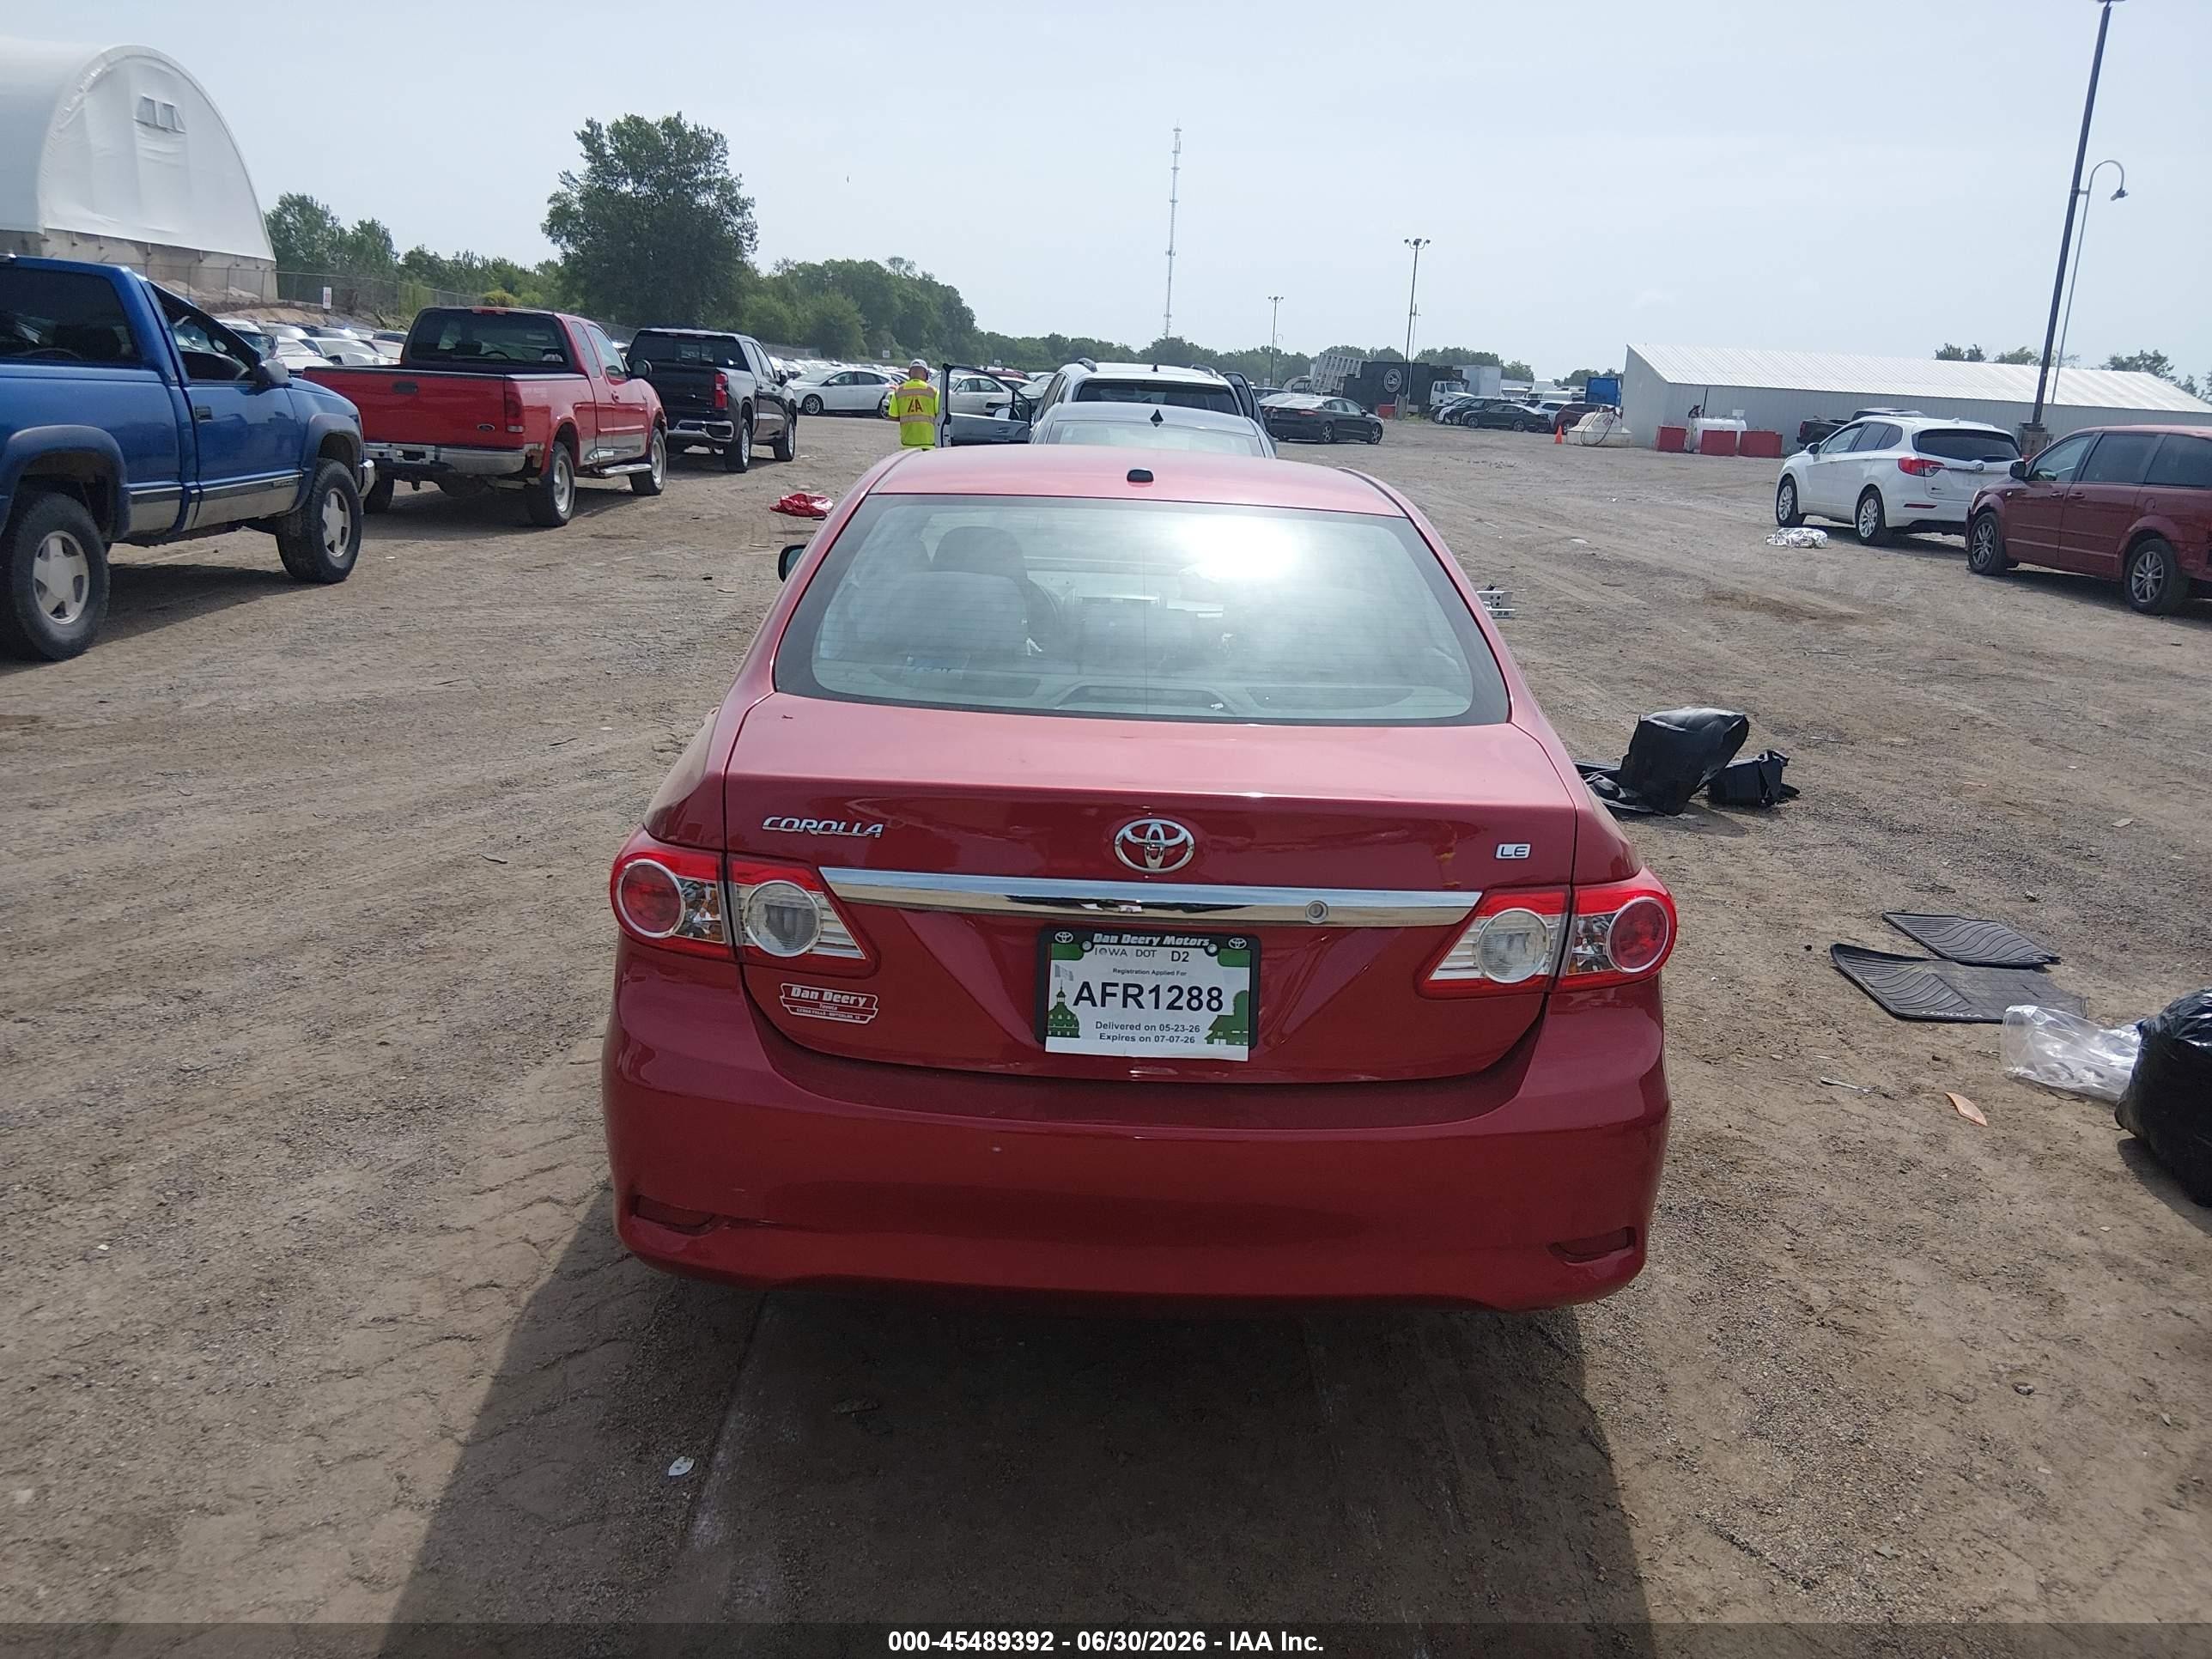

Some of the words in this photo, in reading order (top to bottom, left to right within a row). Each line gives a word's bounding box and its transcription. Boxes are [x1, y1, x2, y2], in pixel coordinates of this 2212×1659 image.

[763, 817, 884, 838] COROLLA
[1500, 846, 1528, 857] LE
[1093, 933, 1118, 944] Dan
[1121, 934, 1160, 945] Deery
[1163, 935, 1210, 946] Motors
[1135, 949, 1157, 957] DOT
[1170, 951, 1189, 963] D2
[791, 987, 819, 1000] Dan
[822, 991, 866, 1007] Deery
[1073, 981, 1224, 1012] AFR1288
[1095, 1021, 1141, 1030] Delivered
[1159, 1024, 1200, 1033] 05-23-26
[1099, 1033, 1136, 1042] Expires
[1154, 1035, 1195, 1043] 07-07-26
